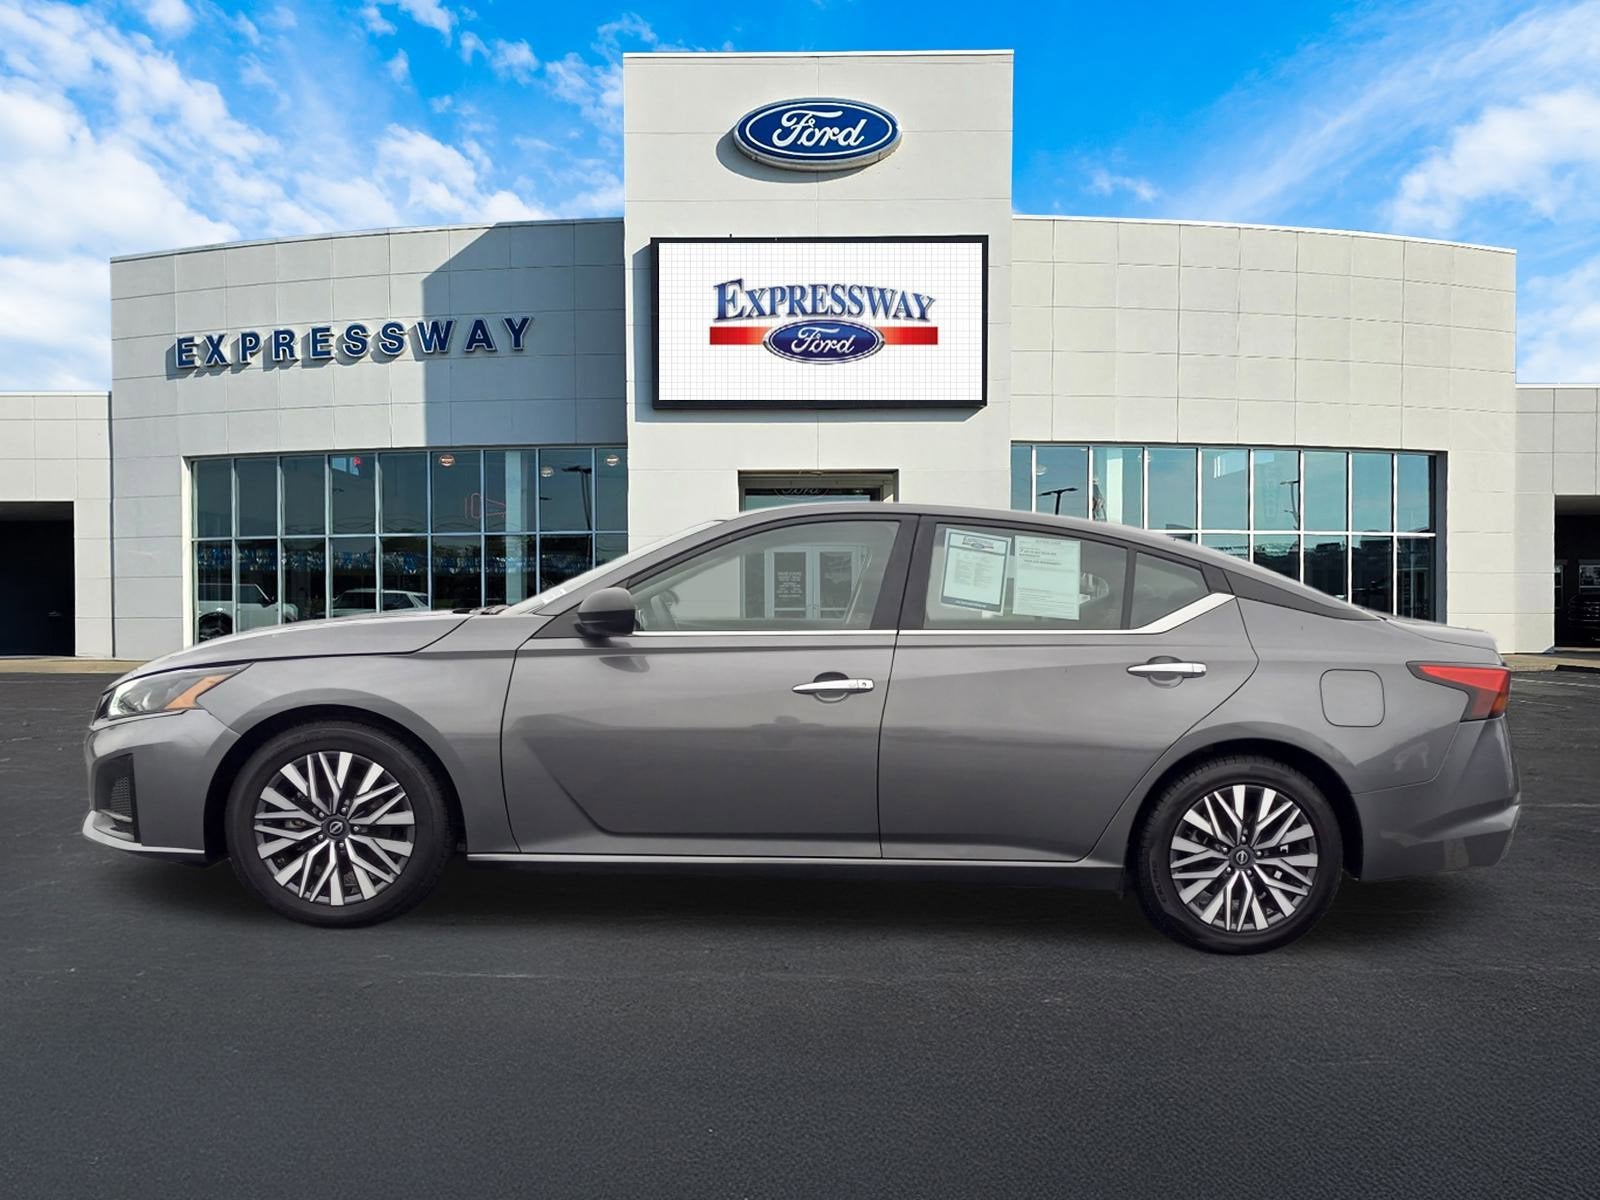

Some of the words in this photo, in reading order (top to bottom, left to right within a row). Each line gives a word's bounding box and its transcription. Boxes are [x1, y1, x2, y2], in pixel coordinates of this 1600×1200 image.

[771, 109, 868, 147] Ford
[175, 315, 533, 370] EXPRESSWAY
[790, 326, 855, 354] Ford
